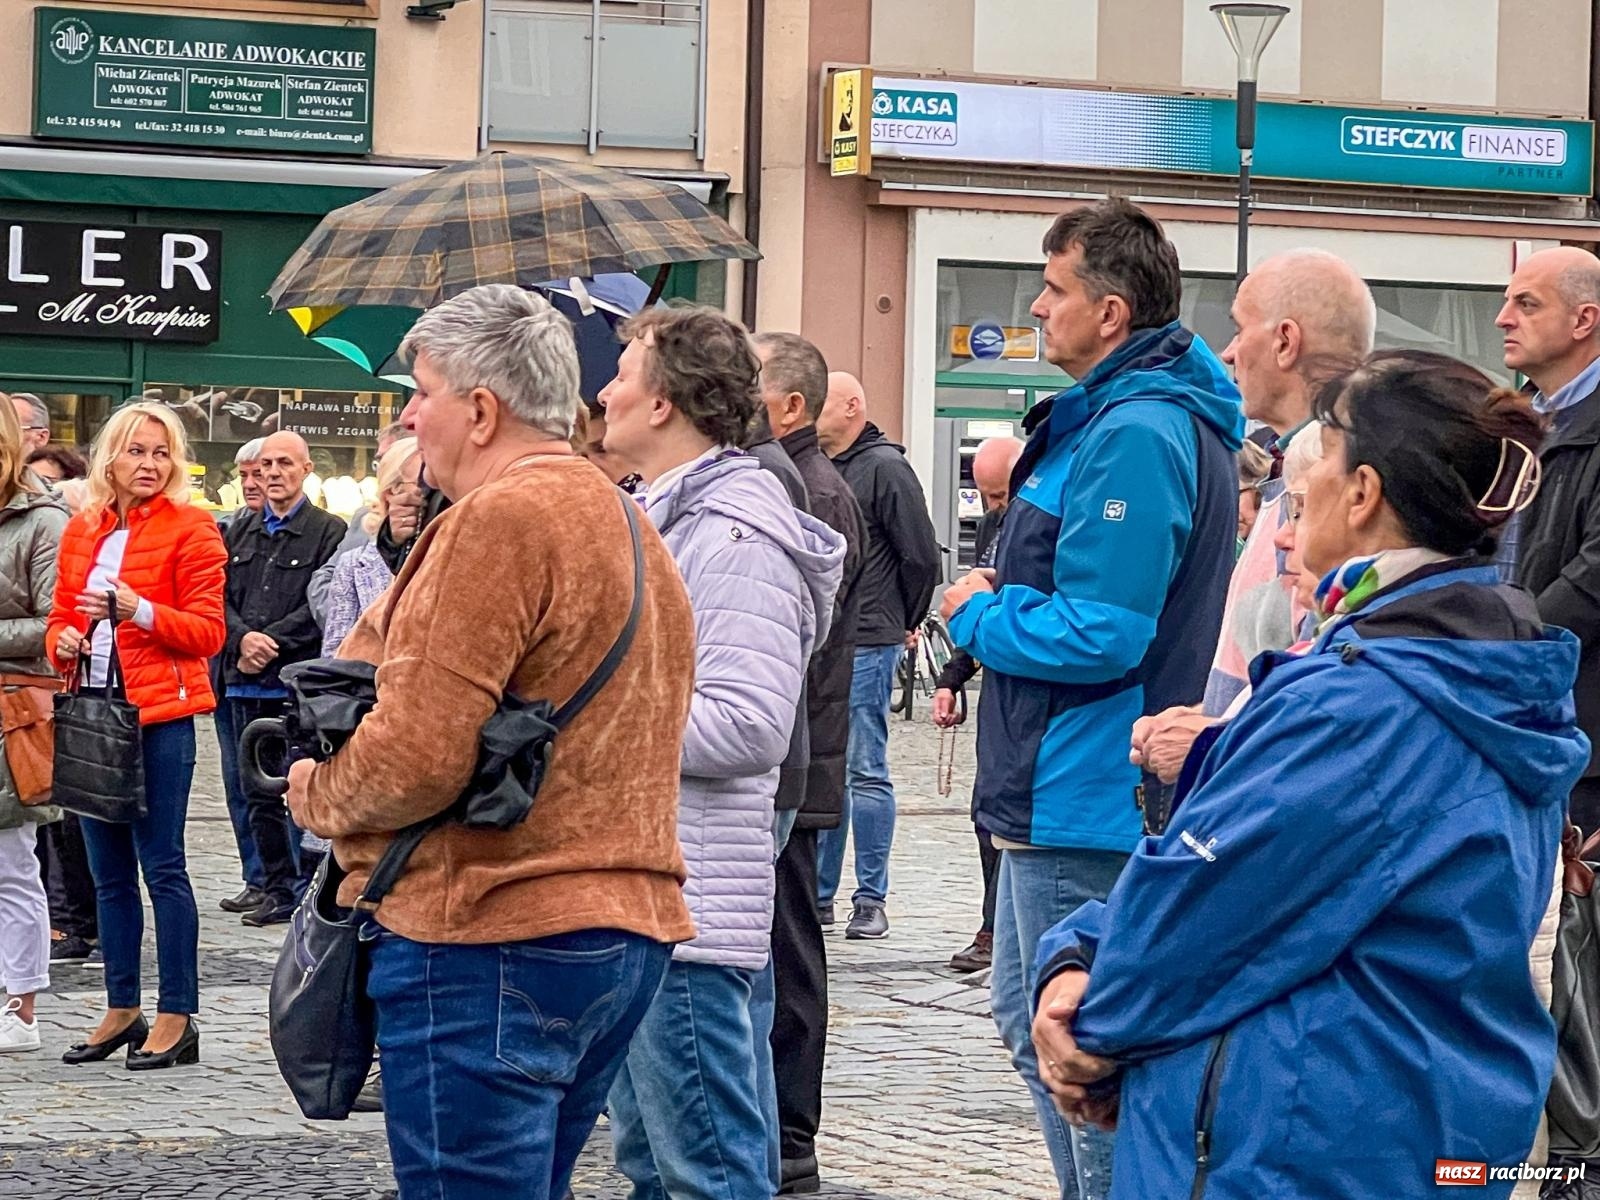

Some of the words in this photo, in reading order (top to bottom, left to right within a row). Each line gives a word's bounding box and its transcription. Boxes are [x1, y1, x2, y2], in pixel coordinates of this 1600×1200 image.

[99, 36, 227, 59] KANCELARIE
[232, 45, 366, 68] ADWOKACKIE
[139, 69, 181, 82] Zientek
[191, 74, 234, 88] Patrycja
[236, 77, 282, 89] Mazurek
[110, 84, 168, 96] ADWOKAT
[287, 79, 321, 91] Stefan
[323, 80, 364, 93] Zientek
[209, 90, 263, 102] ADWOKAT
[297, 95, 354, 107] ADWOKAT
[897, 95, 954, 116] KASA
[66, 117, 76, 125] 32
[78, 117, 96, 127] 415
[96, 118, 108, 127] 94
[109, 119, 121, 128] 94
[170, 123, 181, 132] 32
[202, 124, 214, 134] 15
[214, 125, 225, 134] 30
[236, 127, 267, 137] e-mail:
[872, 122, 953, 141] STEFCZYKA
[1350, 125, 1457, 151] STEFCZYK
[1469, 134, 1556, 157] FINANSE
[1499, 166, 1564, 179] PARTNER
[38, 292, 96, 323] M.
[96, 294, 212, 336] Karpisz
[285, 401, 340, 412] NAPRAWA
[285, 425, 329, 435] SERWIS
